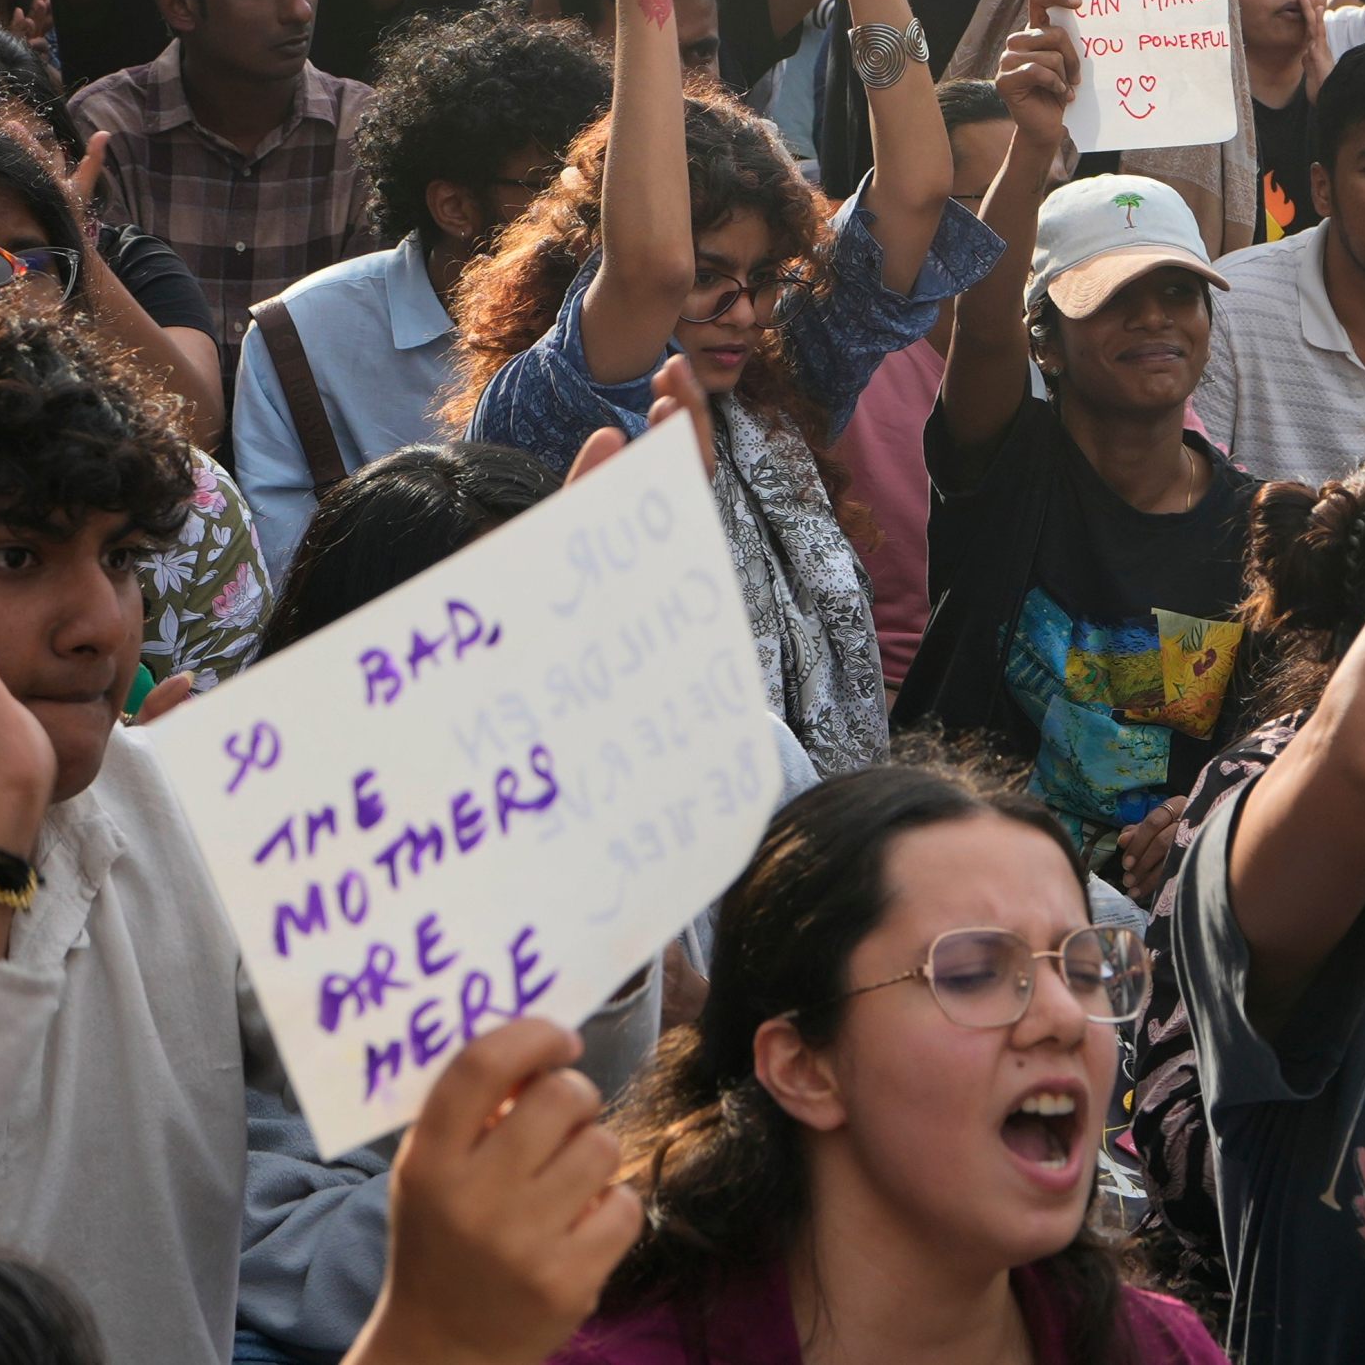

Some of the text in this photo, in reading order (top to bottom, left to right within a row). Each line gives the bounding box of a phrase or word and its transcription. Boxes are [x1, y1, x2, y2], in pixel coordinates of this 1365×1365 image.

[1080, 31, 1229, 59] YOU POWERFUL
[223, 719, 282, 795] SO
[252, 769, 386, 865] THE
[271, 743, 559, 956] MOTHERS
[316, 913, 460, 1033] ARE
[363, 926, 557, 1101] HERE
